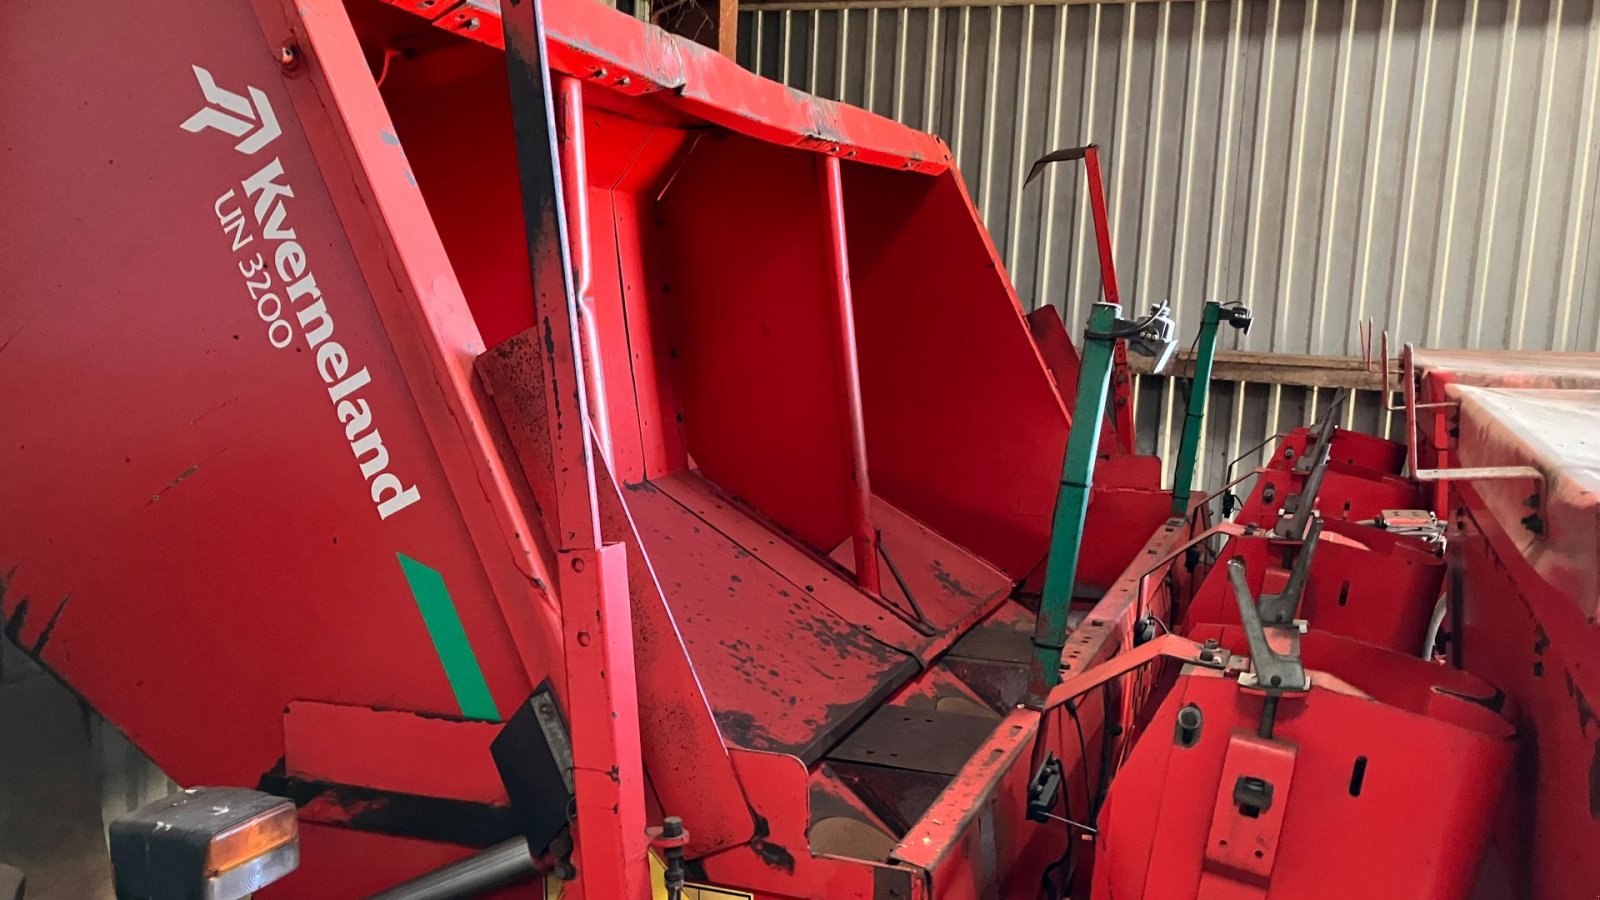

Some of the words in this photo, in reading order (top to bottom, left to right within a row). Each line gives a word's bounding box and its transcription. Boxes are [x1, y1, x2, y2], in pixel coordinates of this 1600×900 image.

[214, 189, 253, 252] UN
[238, 253, 293, 349] 3200
[241, 157, 420, 520] Kverneland
